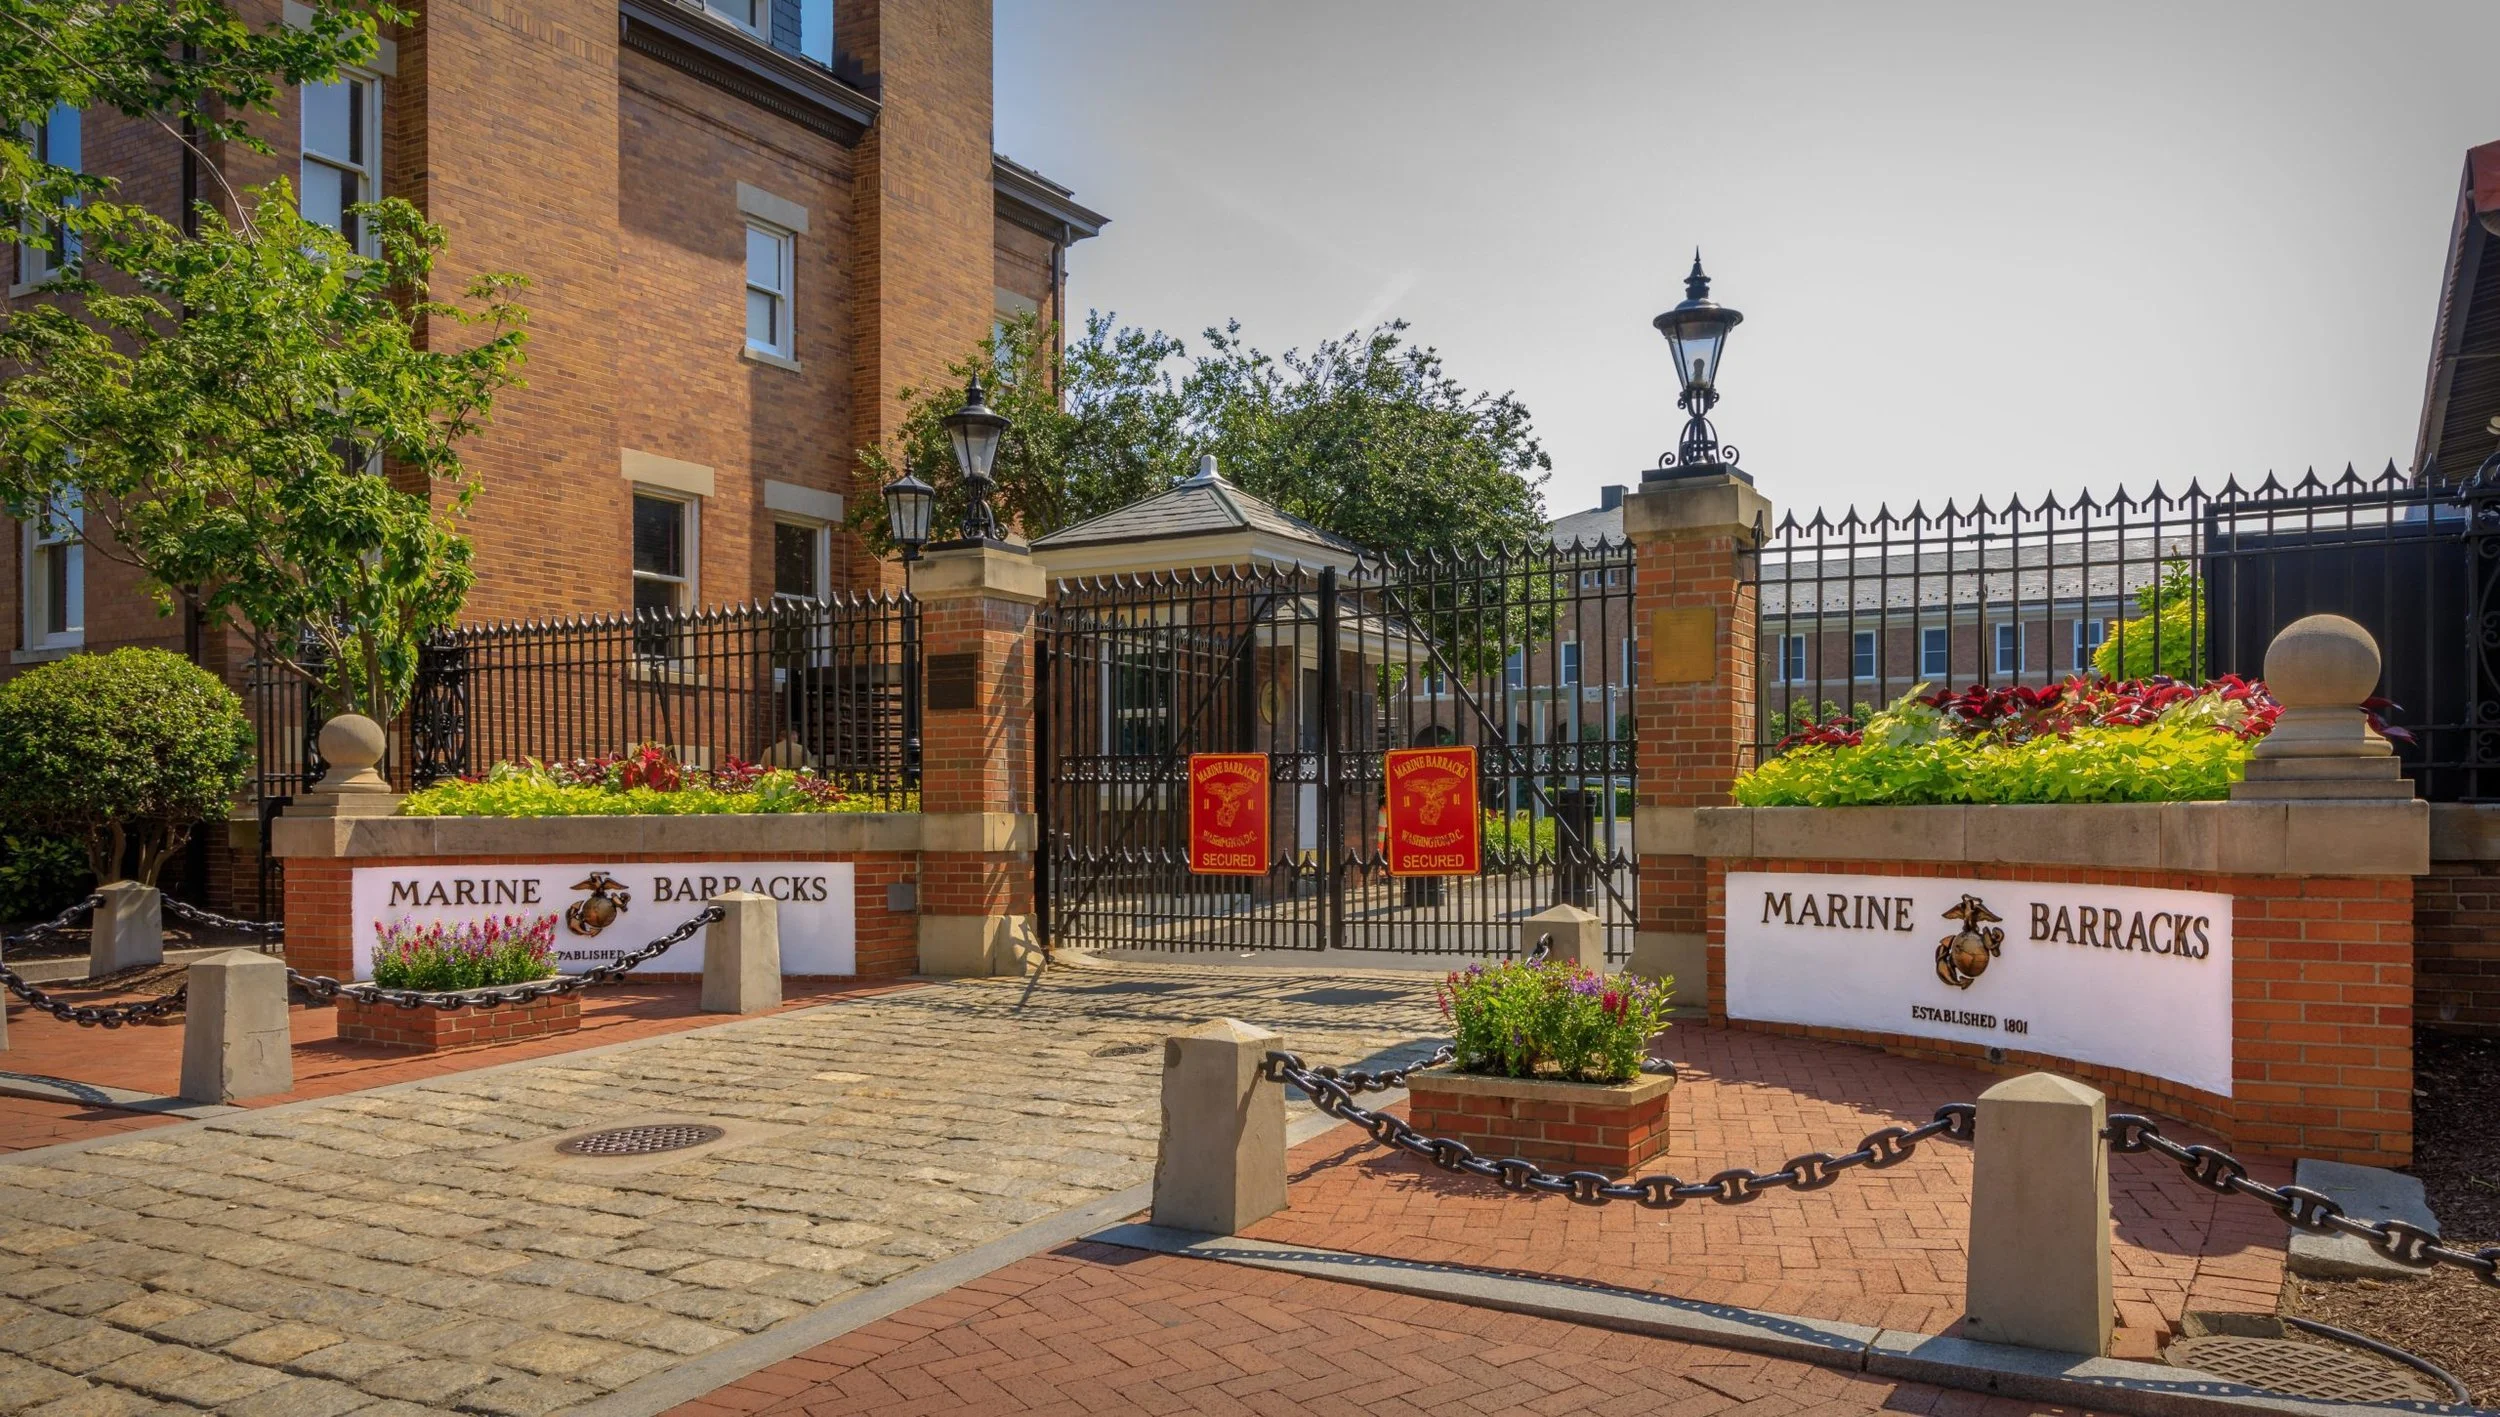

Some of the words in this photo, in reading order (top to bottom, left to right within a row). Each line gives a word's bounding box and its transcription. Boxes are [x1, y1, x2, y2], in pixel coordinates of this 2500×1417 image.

[1196, 762, 1223, 783] MARINE
[1224, 761, 1260, 783] BARRACKS
[1394, 757, 1425, 779] MARINE
[1426, 755, 1469, 778] BARRACKS
[1203, 853, 1256, 867] SECURED
[1403, 854, 1465, 868] SECURED
[388, 879, 541, 907] MARINE
[654, 876, 828, 902] BARRACKS
[1761, 891, 1914, 932] MARINE
[2029, 902, 2211, 960] BARRACKS
[558, 950, 625, 960] TABLISHED
[1911, 1005, 1997, 1029] ESTABLISHED
[2003, 1018, 2028, 1034] 1801
